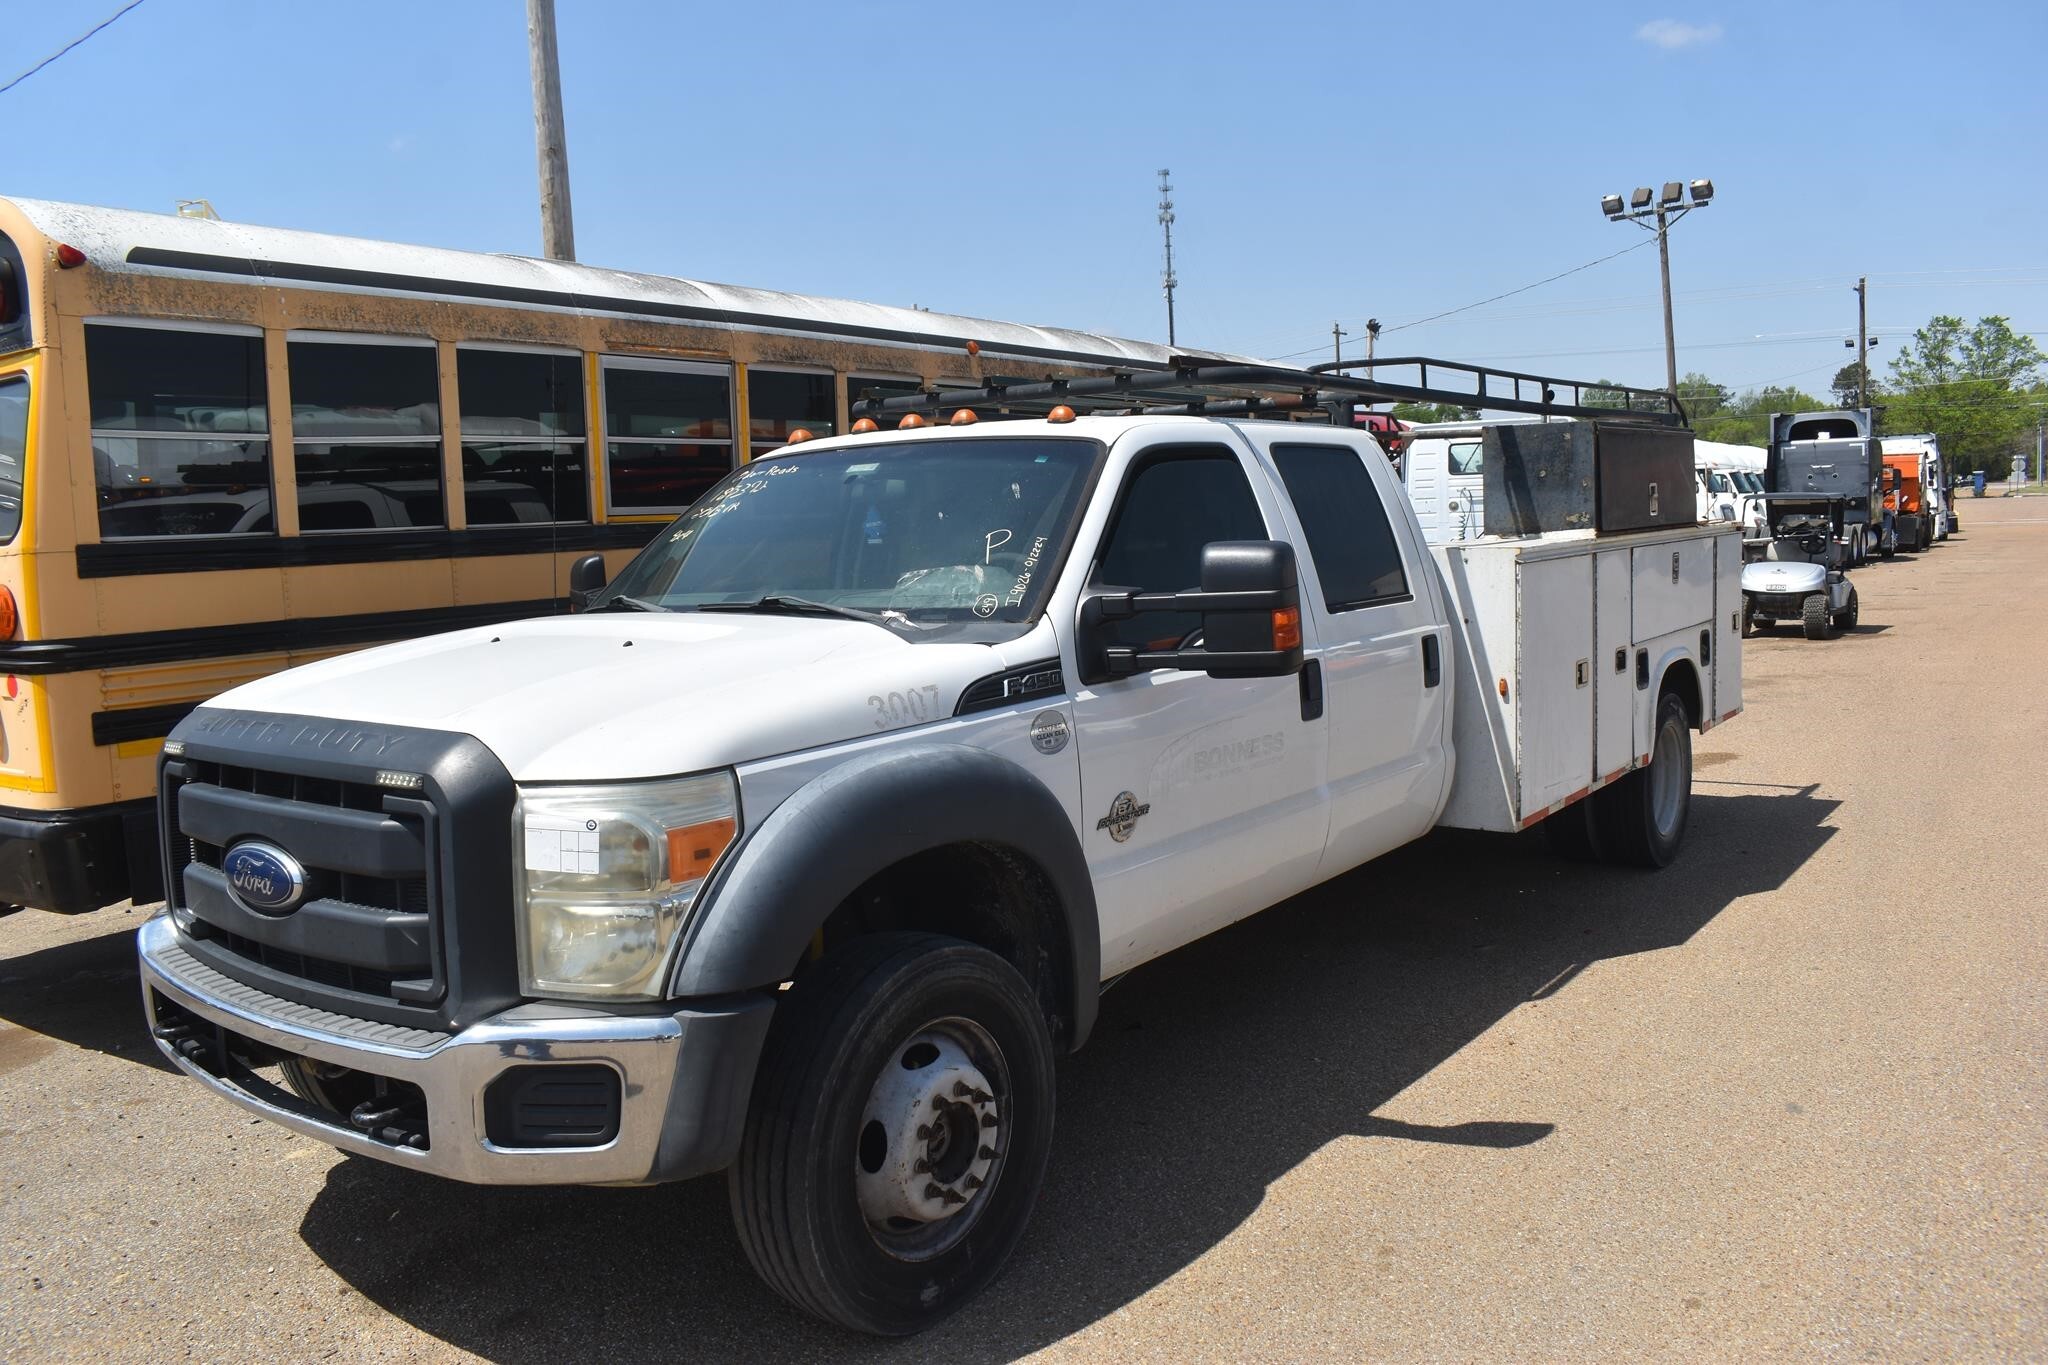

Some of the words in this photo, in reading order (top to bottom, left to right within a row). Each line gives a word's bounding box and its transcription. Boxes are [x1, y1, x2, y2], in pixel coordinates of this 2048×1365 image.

[985, 528, 1012, 565] P
[867, 684, 940, 730] 3007
[195, 714, 284, 743] SUPER
[290, 725, 405, 756] DUTY
[234, 855, 275, 896] Ford
